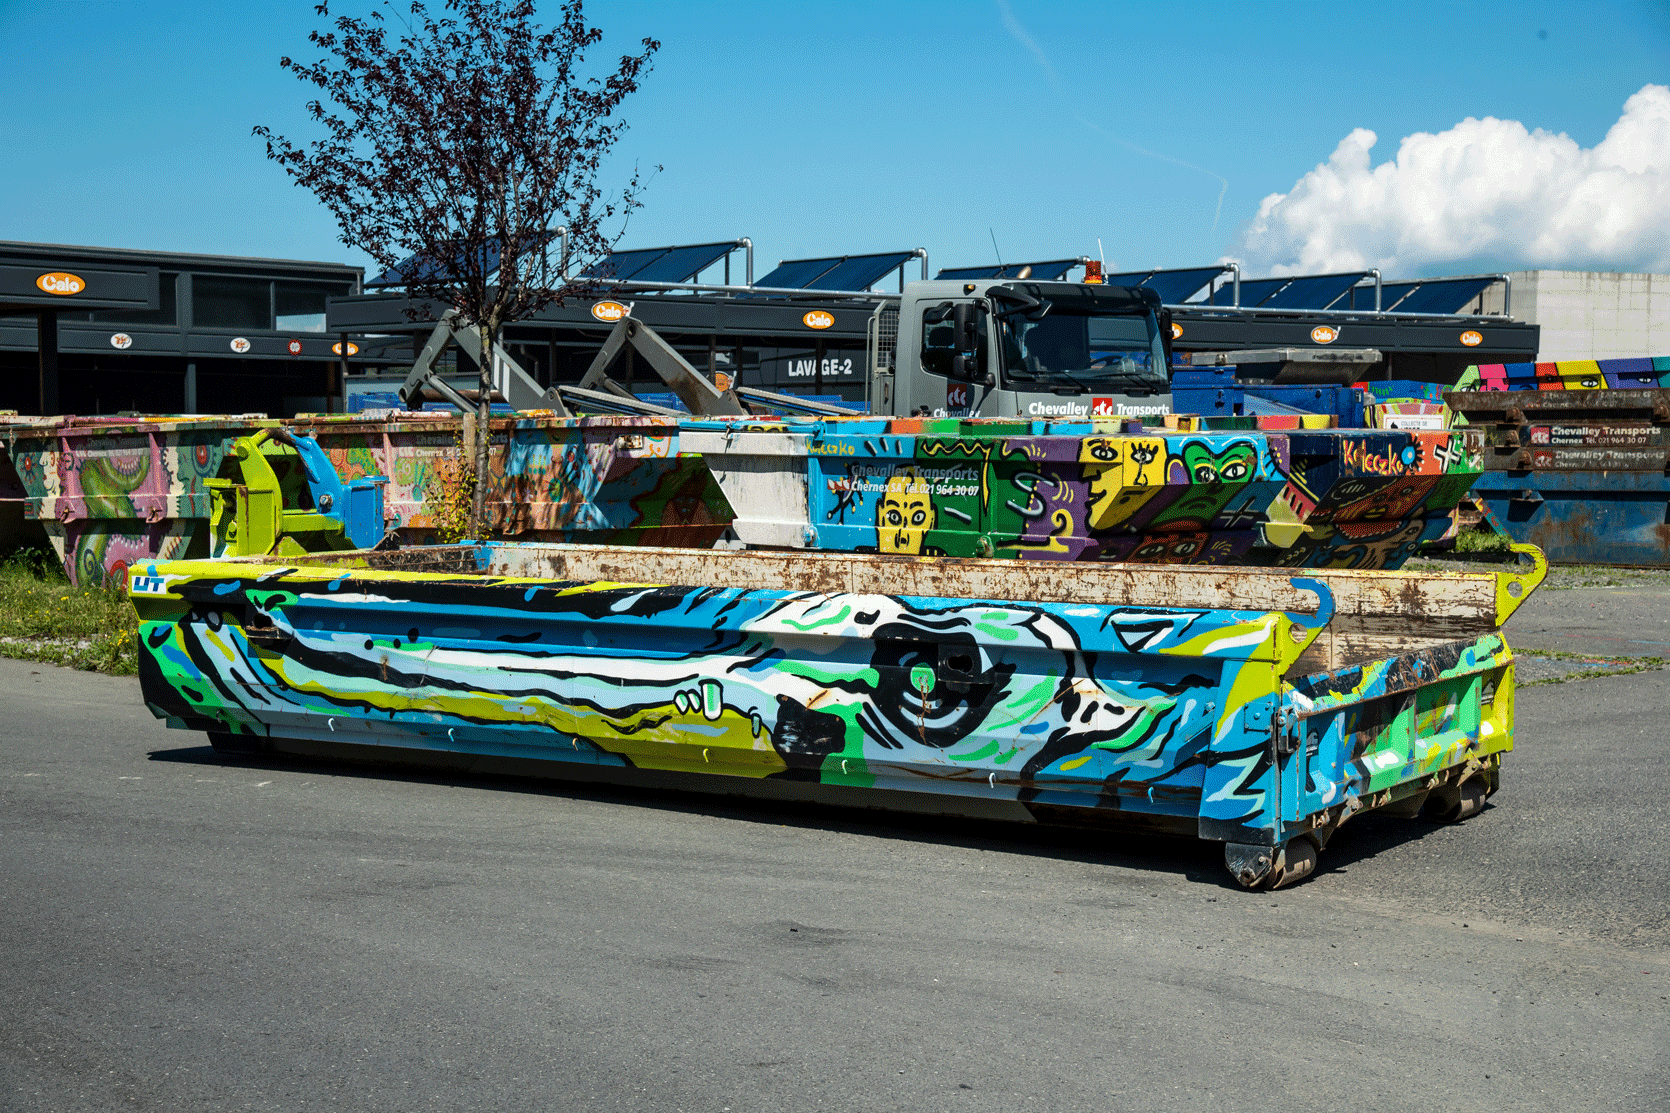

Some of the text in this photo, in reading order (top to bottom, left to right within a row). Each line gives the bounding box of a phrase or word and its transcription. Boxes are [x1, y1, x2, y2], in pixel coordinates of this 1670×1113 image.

[43, 276, 80, 292] Calo
[596, 305, 621, 318] Calo
[806, 313, 831, 327] Calo
[1313, 329, 1331, 341] Calo
[1462, 332, 1480, 344] Calo
[1028, 401, 1089, 416] Chevalley
[1116, 403, 1170, 416] Transports
[1551, 426, 1601, 437] Chevalley
[1603, 426, 1661, 437] Transports
[851, 463, 979, 484] Chevalley Transports
[851, 479, 890, 493] Chernex
[891, 482, 903, 493] SA
[920, 483, 934, 495] 021
[936, 484, 952, 496] 964
[954, 485, 966, 496] 30
[968, 485, 979, 497] 07
[133, 577, 165, 591] UT
